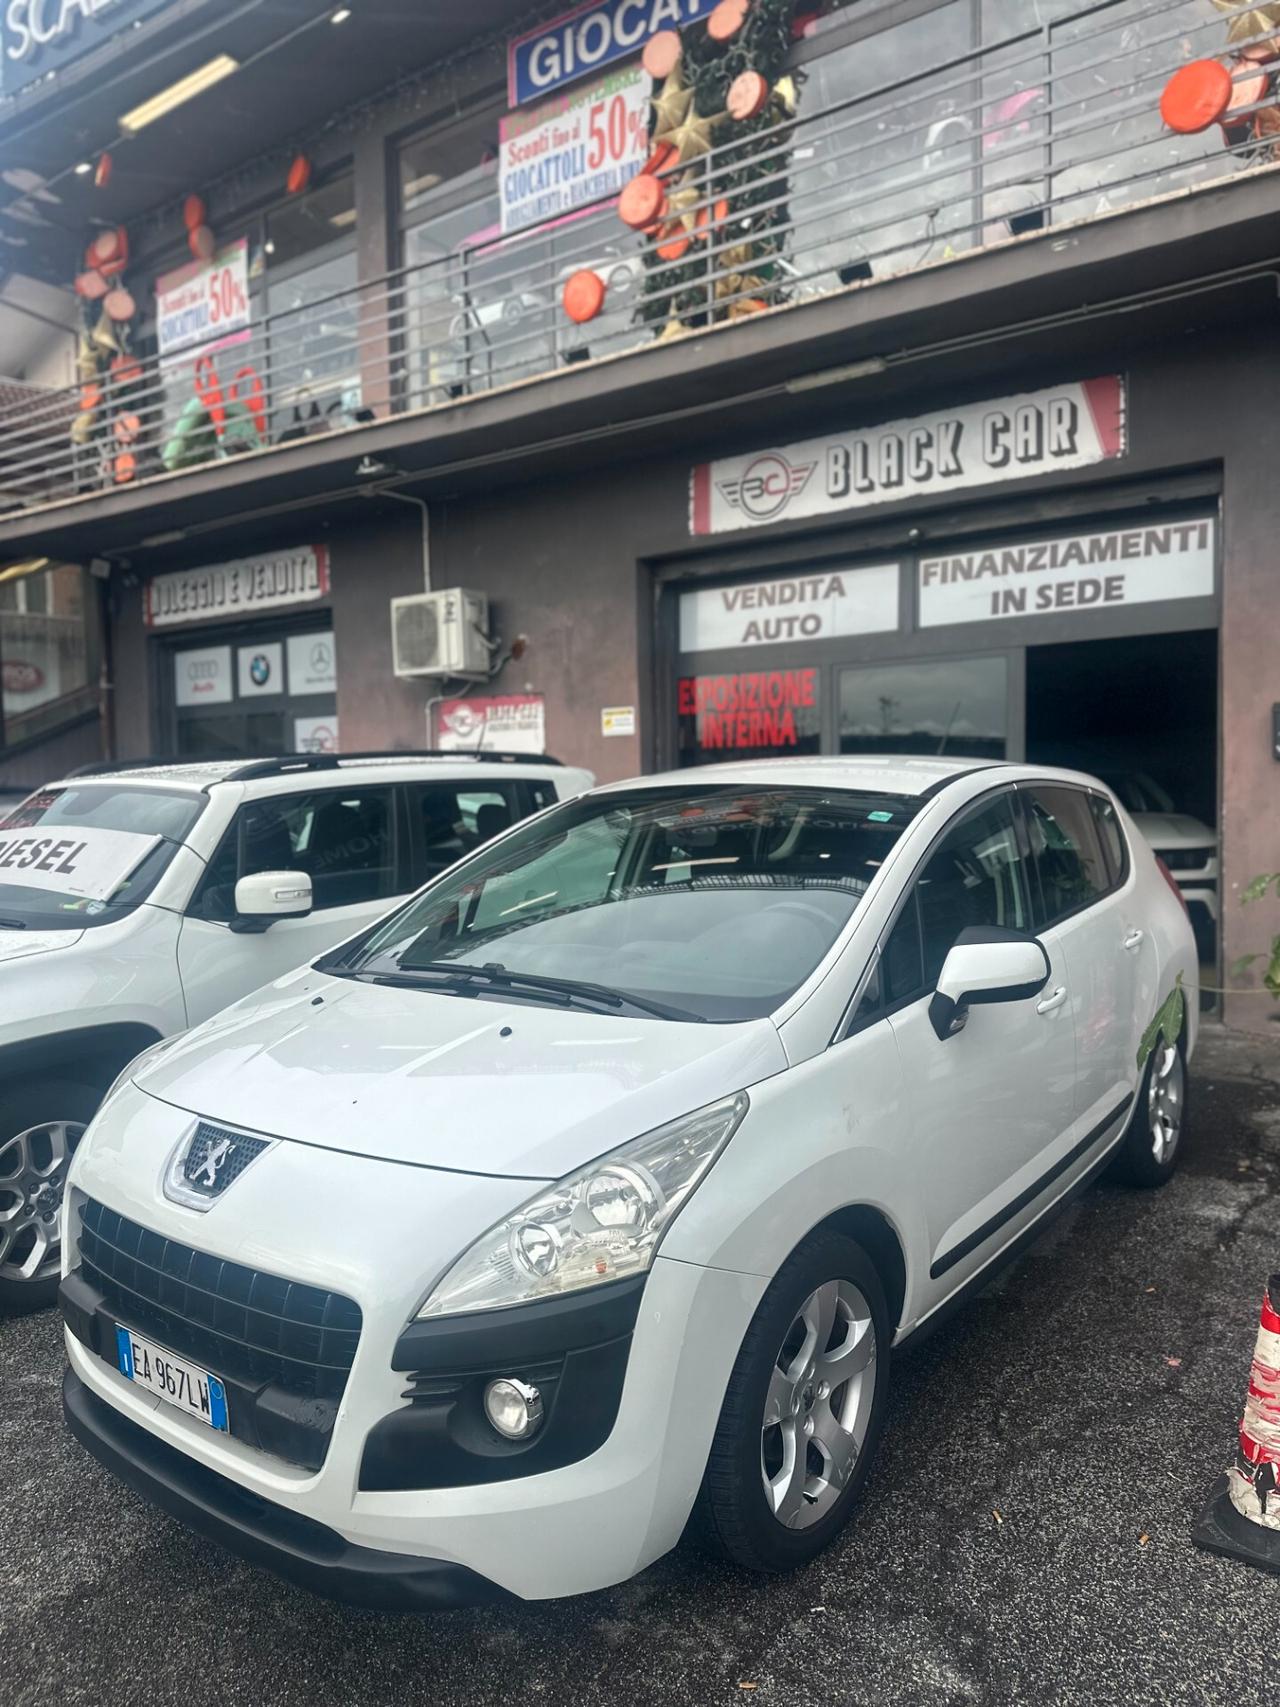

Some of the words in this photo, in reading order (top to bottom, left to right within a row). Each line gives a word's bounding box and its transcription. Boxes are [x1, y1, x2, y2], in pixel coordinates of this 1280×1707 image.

[528, 0, 699, 87] GIOCA
[508, 127, 549, 167] Sconti
[588, 95, 648, 170] 50%
[505, 143, 585, 204] GIOCATTOLI
[209, 267, 246, 324] 50%
[826, 420, 964, 498] BLACK
[982, 397, 1078, 468] CAR
[246, 553, 320, 601] VENDITA
[922, 522, 1208, 587] FINANZIAMENTI
[721, 575, 846, 612] VENDITA
[991, 587, 1027, 615] IN
[1035, 575, 1125, 609] SEDE
[741, 614, 822, 643] AUTO
[677, 667, 816, 715] ESPOSIZIONE
[702, 708, 798, 749] INTERNA
